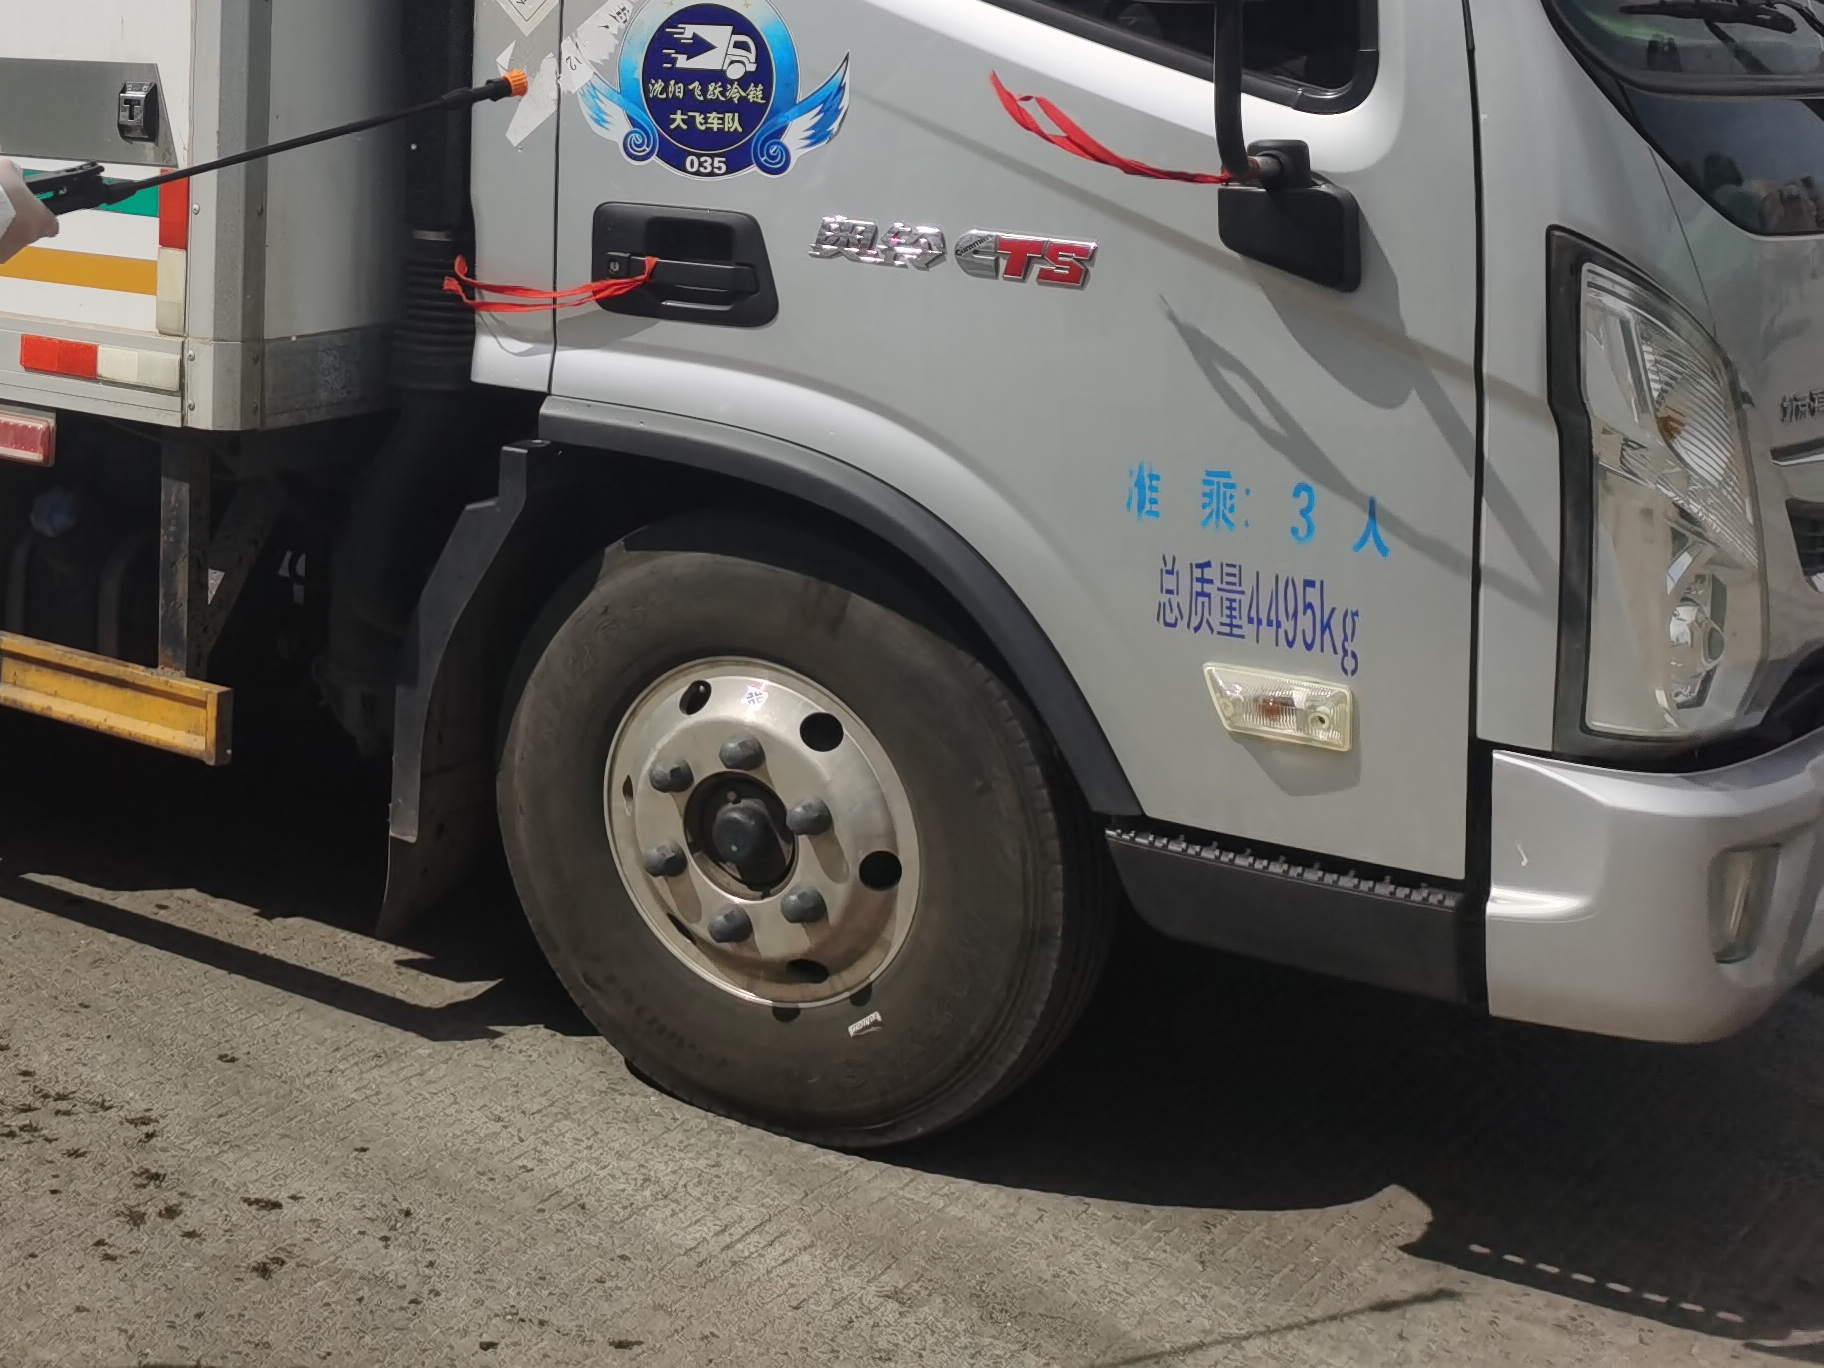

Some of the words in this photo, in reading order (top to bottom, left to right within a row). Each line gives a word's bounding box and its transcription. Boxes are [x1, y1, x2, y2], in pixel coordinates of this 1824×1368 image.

[648, 78, 767, 104] 沈阳飞跃冷链
[669, 109, 743, 132] 大飞车队
[685, 155, 727, 174] 035
[1156, 553, 1363, 677] 总质量4495kg
